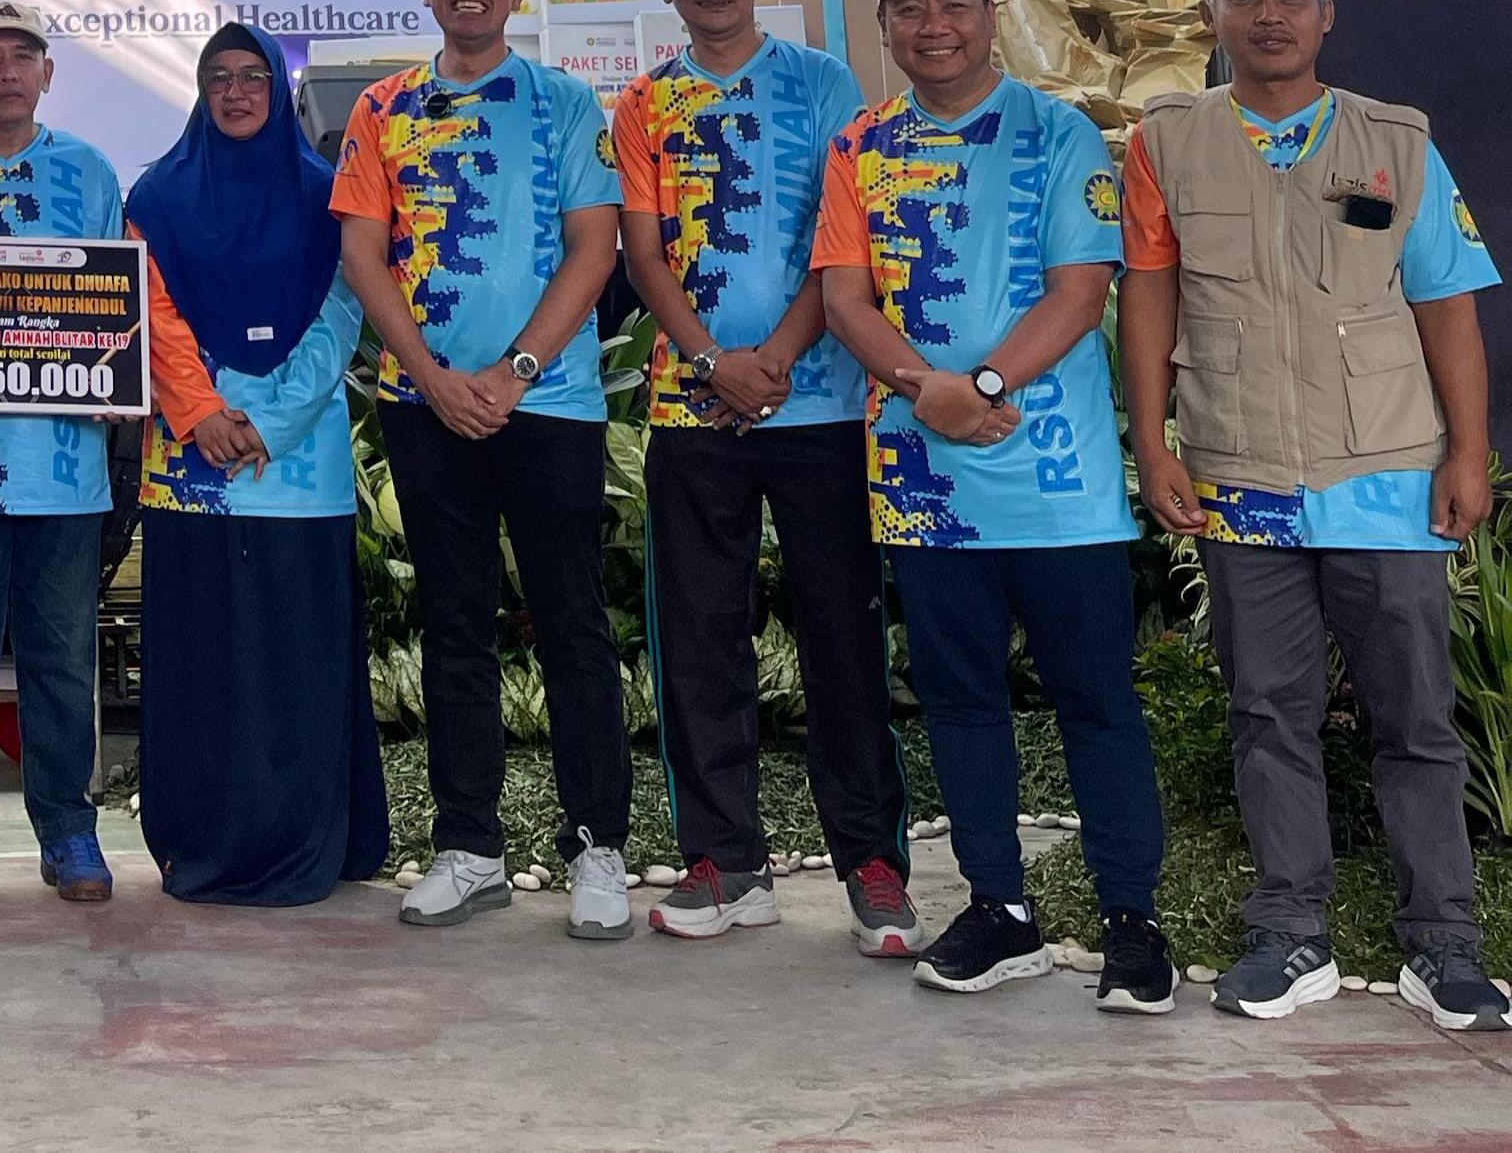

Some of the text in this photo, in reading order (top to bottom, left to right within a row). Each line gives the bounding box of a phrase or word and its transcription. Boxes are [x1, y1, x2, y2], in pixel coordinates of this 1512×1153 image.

[36, 6, 224, 46] xceptional
[237, 4, 421, 34] Healthcare
[562, 56, 608, 71] PAKET
[1007, 127, 1047, 311] MINAH
[23, 272, 72, 291] UNTUK
[74, 274, 130, 293] DHUAFA
[16, 295, 127, 315] KEPANJENKIDUL
[17, 314, 60, 329] Rangka
[1, 329, 51, 347] AMINAH
[52, 330, 96, 348] BLITAR
[97, 332, 113, 349] KE
[114, 332, 130, 350] 19
[1025, 372, 1087, 498] RSU
